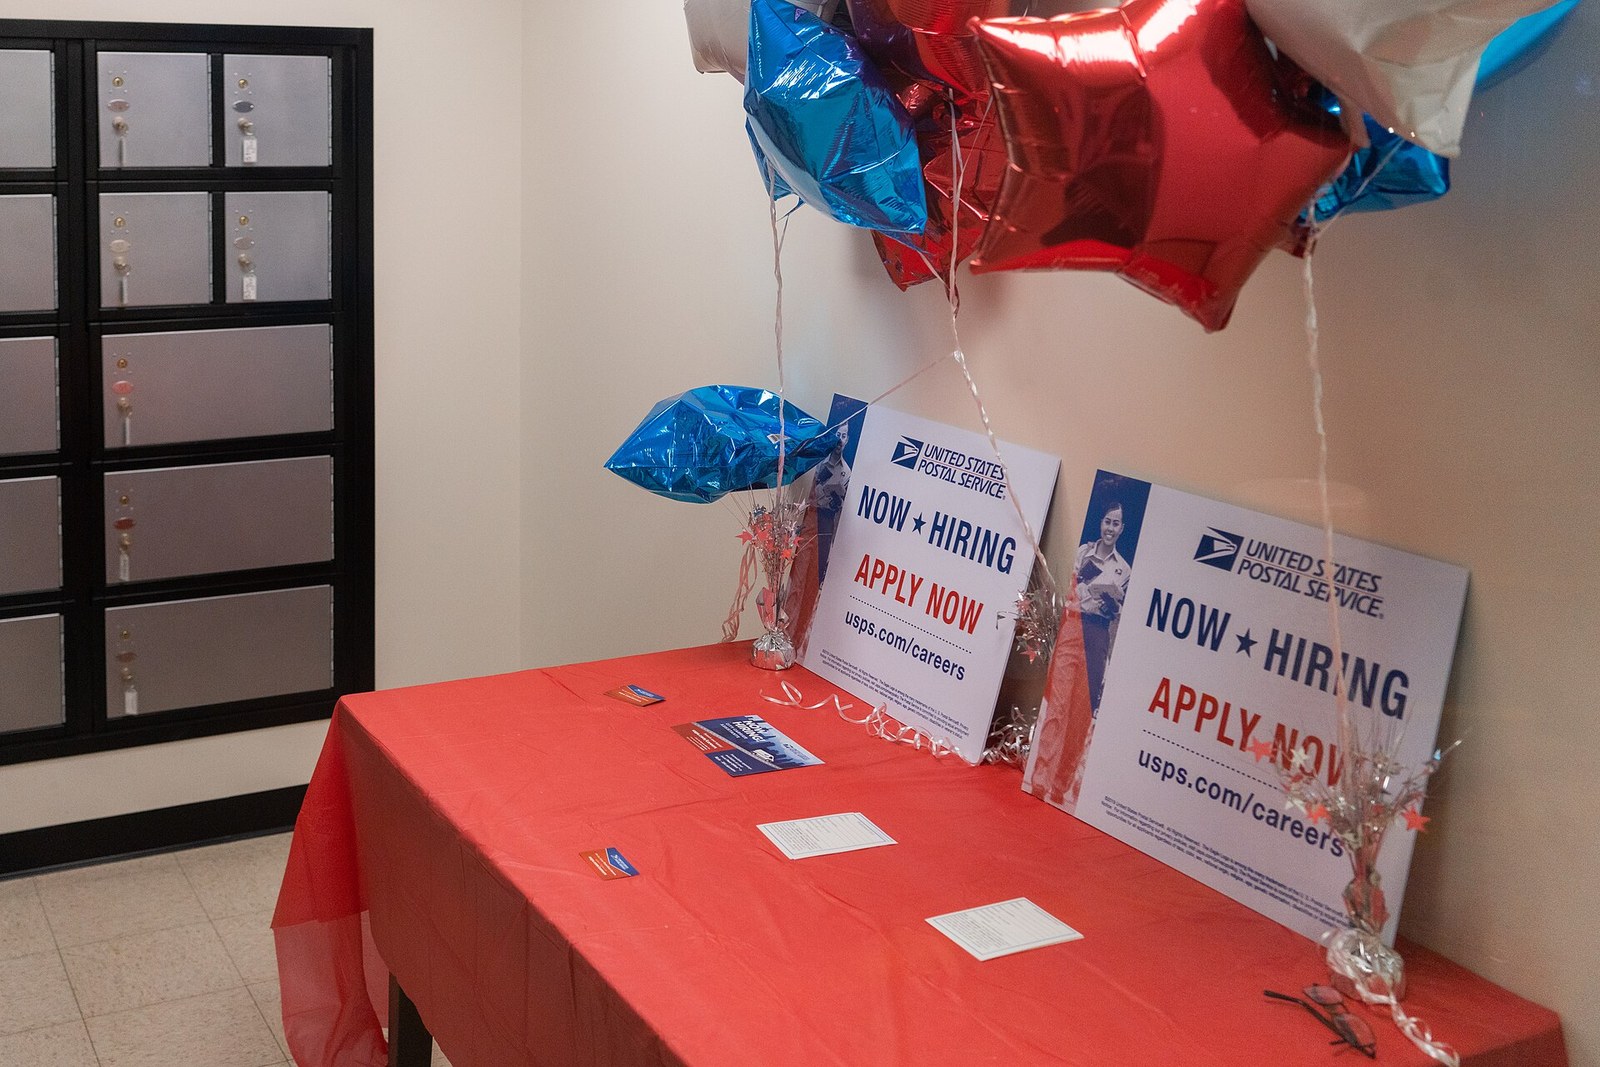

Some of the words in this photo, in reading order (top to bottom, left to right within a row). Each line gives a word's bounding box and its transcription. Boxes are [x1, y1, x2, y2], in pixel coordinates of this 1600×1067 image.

[917, 459, 957, 484] POSTAL
[924, 443, 966, 467] UNITED
[965, 456, 1005, 480] STATES
[857, 485, 912, 532] NOW
[928, 511, 1017, 575] HIRING
[1246, 541, 1314, 573] UNITED
[853, 553, 924, 608] APPLY
[925, 582, 984, 635] NOW
[1237, 558, 1302, 593] POSTAL
[845, 611, 966, 681] usps.com/careers
[1145, 587, 1232, 652] NOW
[1263, 628, 1410, 720] HIRING
[1148, 677, 1262, 753] APPLY
[1138, 749, 1344, 858] usps.com/careers
